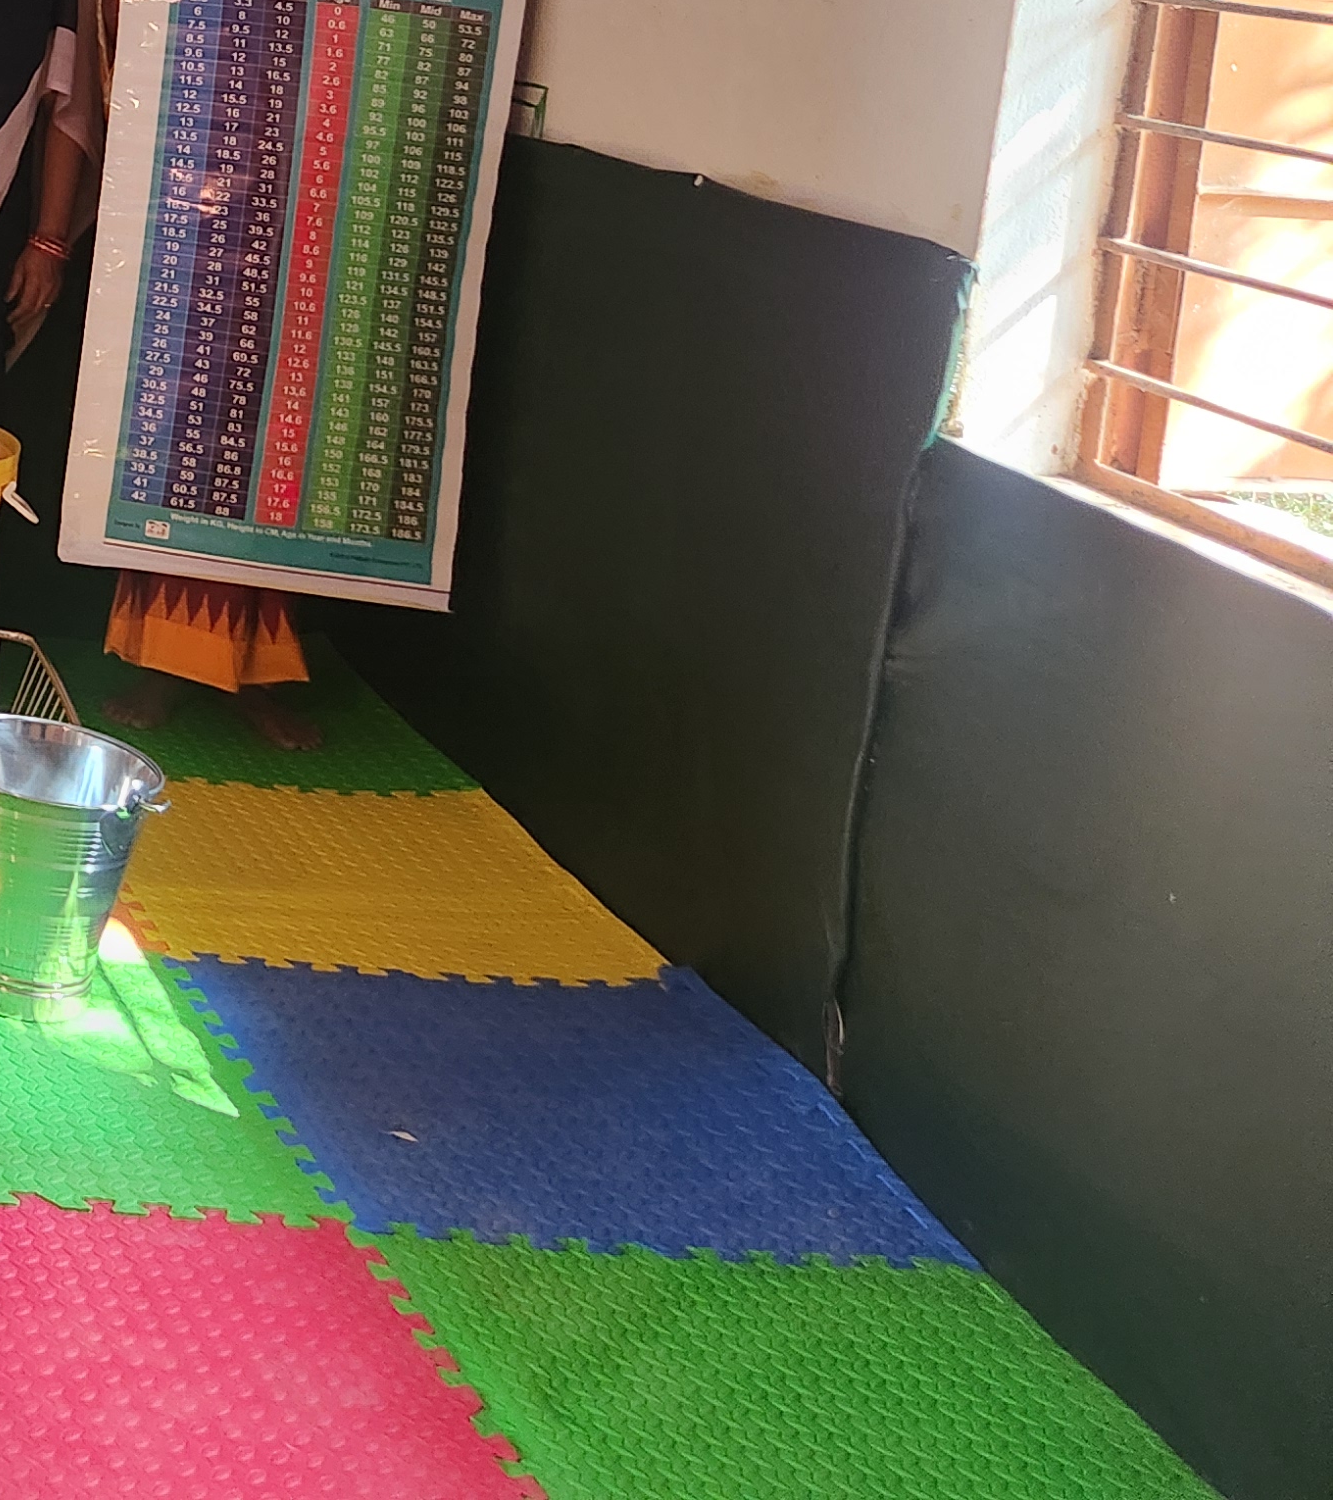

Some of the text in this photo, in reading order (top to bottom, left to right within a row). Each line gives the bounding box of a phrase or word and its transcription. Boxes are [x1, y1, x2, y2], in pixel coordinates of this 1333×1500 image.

[275, 2, 293, 11] 4.5
[335, 7, 341, 15] 0
[379, 0, 401, 10] Min
[421, 5, 442, 16] Mid
[460, 10, 484, 21] Max
[188, 20, 337, 43] 7.5 9.5 12 1
[185, 48, 336, 71] 9.6 12 15 2
[180, 75, 333, 99] 11.5 14 18 3
[176, 103, 330, 127] 12.5 16 21 4
[174, 130, 327, 155] 13.5 18 24.5 5
[171, 158, 323, 184] 14.5 19 28 6
[164, 213, 316, 240] 17.5 25 39.5 8
[166, 242, 313, 268] 19 27 45.5 9
[161, 269, 313, 297] 21 31 51.5 10
[153, 296, 308, 325] 22.5 34.5 58 11
[154, 324, 306, 353] 25 39 66 12
[146, 351, 303, 382] 27.5 43 72 13
[143, 378, 299, 410] 30.5 48 78 14
[139, 406, 295, 438] 34.5 53 83 15
[139, 436, 291, 466] 37 56.5 86 16
[131, 462, 287, 493] 39.5 59 87.5 17
[131, 491, 282, 521] 42 61.5 88 18
